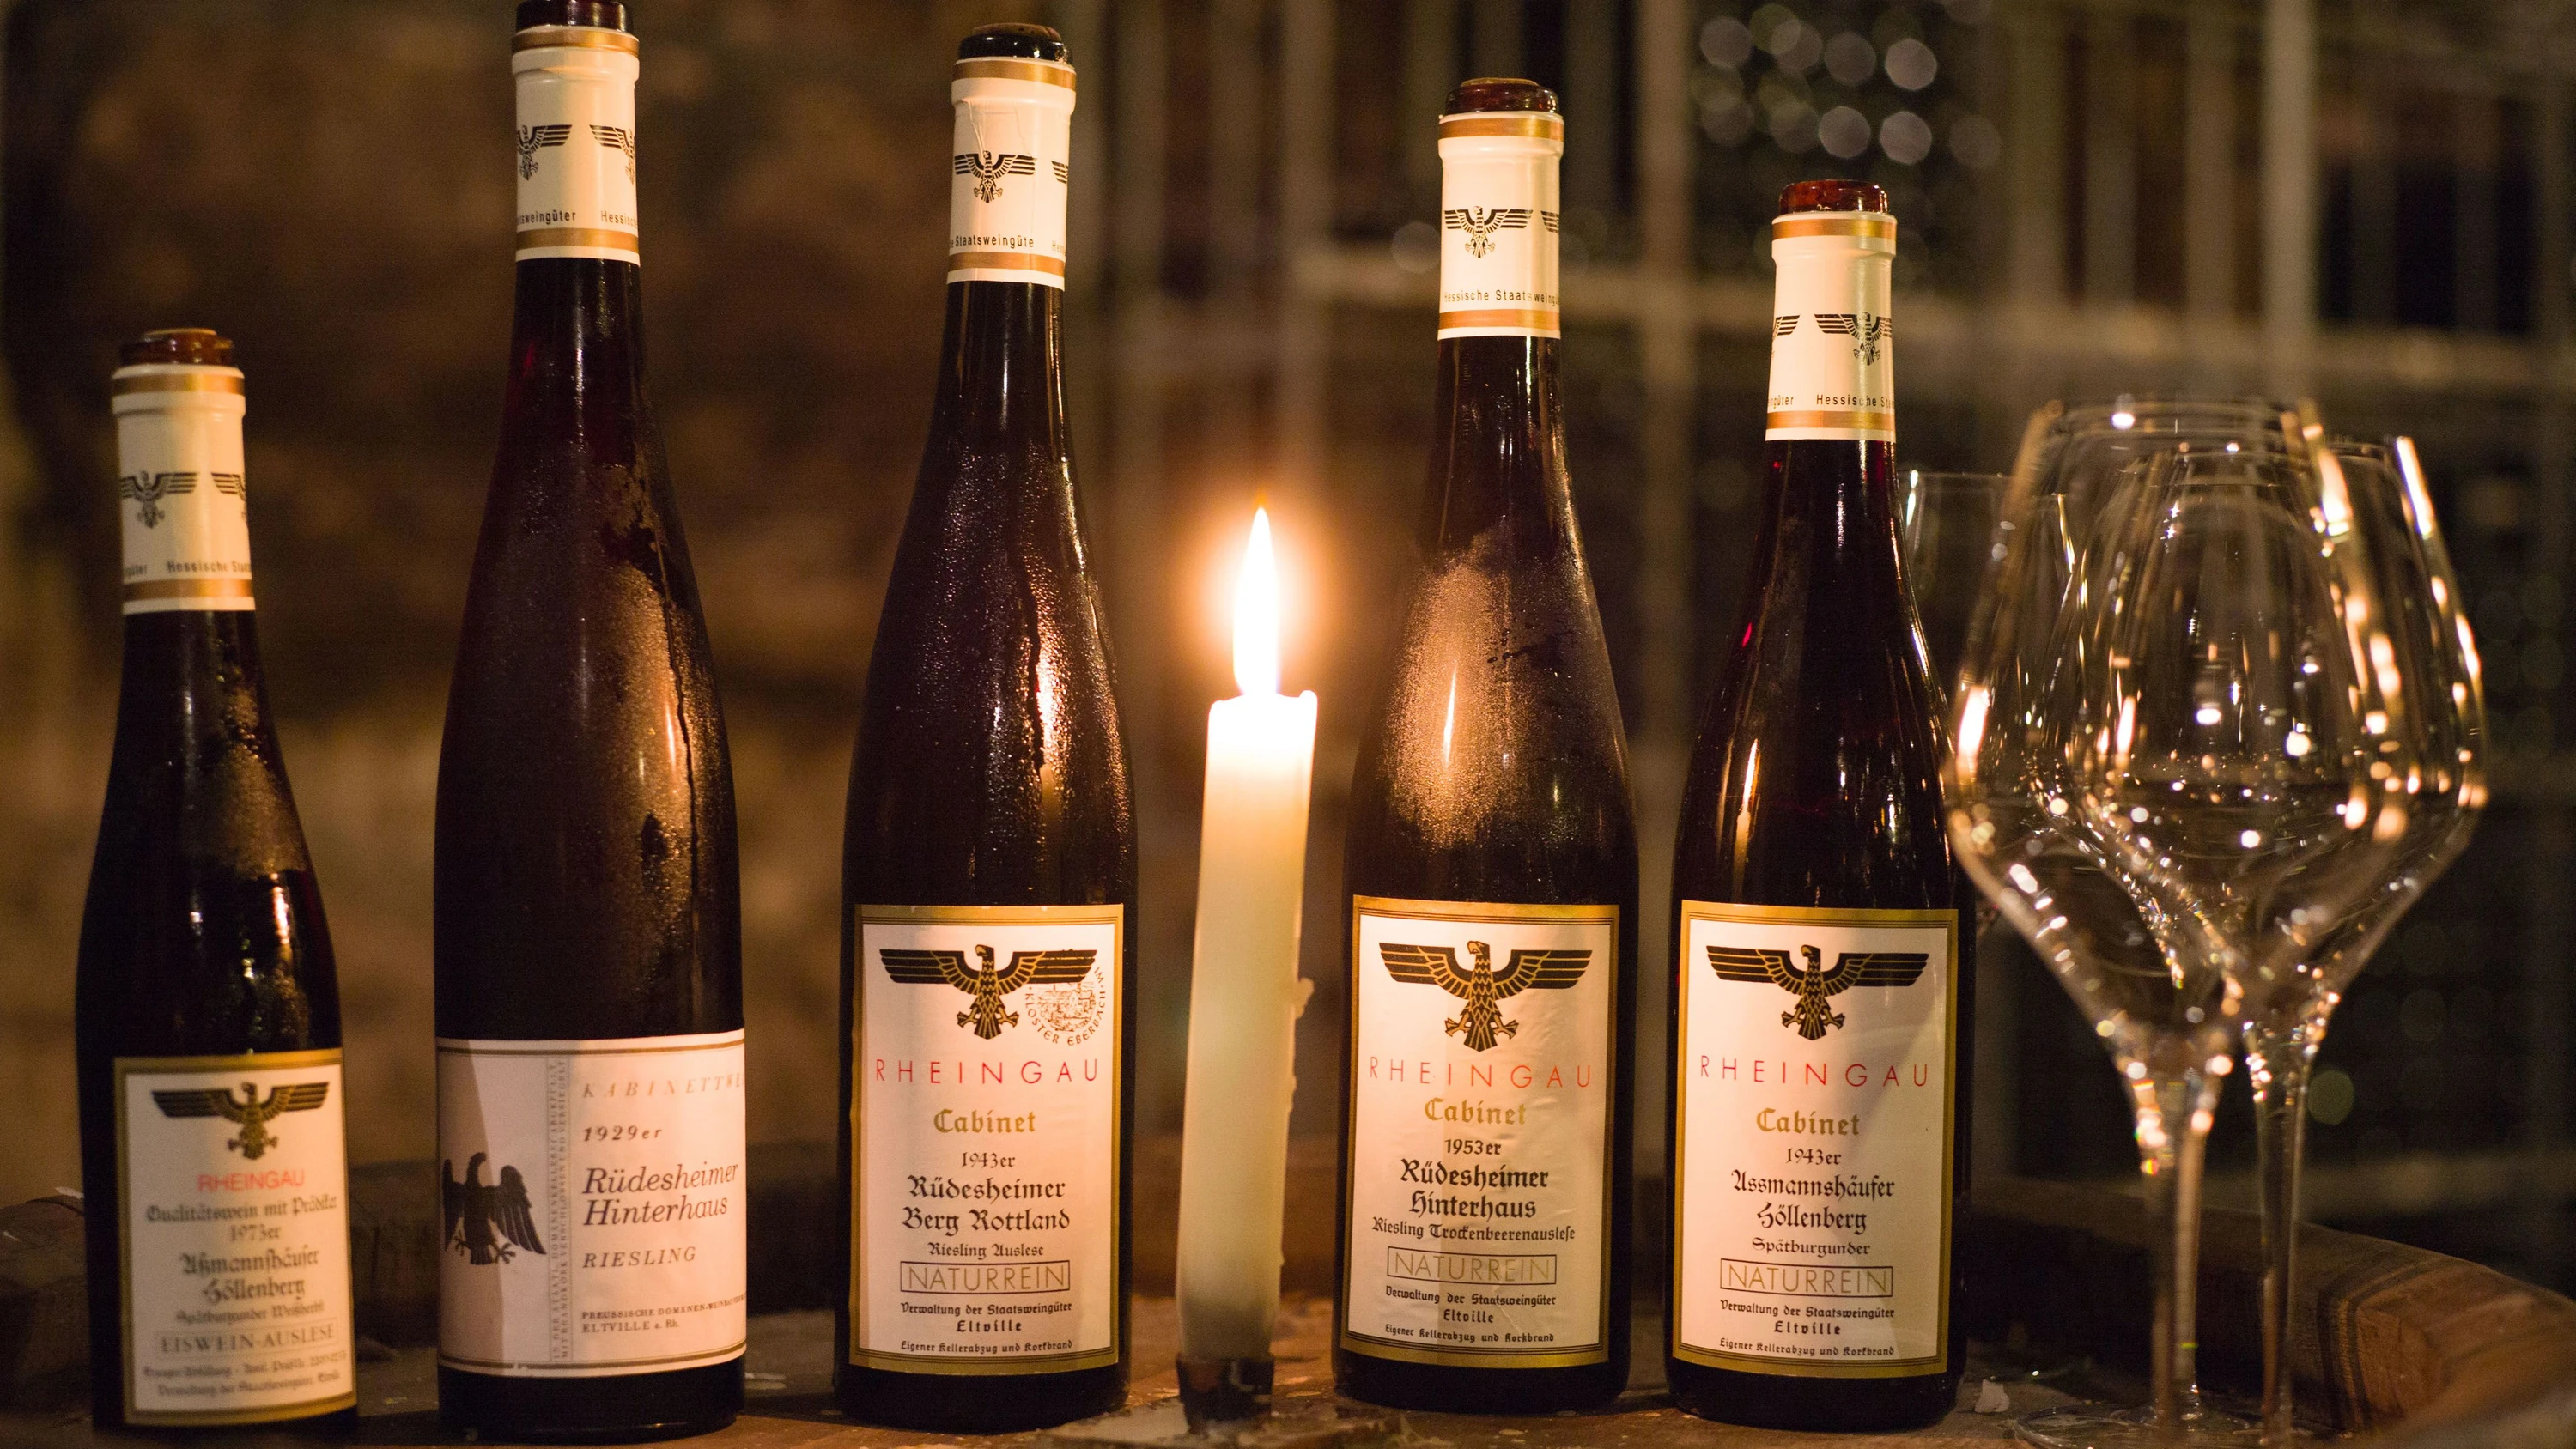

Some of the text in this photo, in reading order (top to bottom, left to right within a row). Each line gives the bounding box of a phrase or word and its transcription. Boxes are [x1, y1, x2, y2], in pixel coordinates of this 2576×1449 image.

[1816, 394, 1877, 407] Hessische
[1024, 991, 1106, 1046] KLOSTER EBERBACH
[875, 1058, 1097, 1084] RHEINGAU
[1370, 1056, 1591, 1088] RHEINGAU
[1701, 1055, 1928, 1088] RHEINGAU
[933, 1108, 1036, 1134] Cabinet
[1424, 1097, 1527, 1125] Cabinet
[1756, 1107, 1861, 1137] Cabinet
[584, 1125, 662, 1142] 1929er
[1444, 1138, 1502, 1155] 1953er
[1785, 1148, 1842, 1165] 1943er
[961, 1152, 1016, 1169] 1943er
[198, 1168, 304, 1191] RHEINGAU
[582, 1161, 738, 1195] Rüdesheimer
[1400, 1158, 1550, 1192] Rüdesheimer
[907, 1174, 1066, 1205] Rüdesheimer
[583, 1194, 728, 1228] Hinterhaus
[1408, 1190, 1537, 1222] Hinterhaus
[901, 1205, 1071, 1237] Berg Rottland
[1372, 1216, 1424, 1240] Riesling
[1756, 1202, 1868, 1235] Höllenberg
[583, 1246, 696, 1269] RIESLING
[927, 1241, 1044, 1260] Riesling Auslese
[1752, 1237, 1871, 1258] Spätburgunder
[908, 1264, 1065, 1291] NATURREIN
[1394, 1252, 1550, 1282] NATURREIN
[1728, 1264, 1887, 1294] NATURREIN
[1385, 1285, 1557, 1307] Verwaltung der Staatsweingüter
[581, 1309, 654, 1319] PREUSSISCHE
[901, 1302, 1072, 1317] Verwaltung der Staatsweingüter
[1720, 1300, 1895, 1319] Verwaltung der Staatsweingüter
[581, 1320, 650, 1333] ELTVILLE
[956, 1320, 1022, 1332] Eltville
[1385, 1324, 1554, 1343] Eigener Kellerabzug und Korkbrand
[1774, 1320, 1841, 1335] Eltville
[161, 1323, 335, 1354] EISWEIN-AUSLESE
[901, 1340, 936, 1353] Eigener
[939, 1341, 998, 1355] Kellerabzug
[1002, 1342, 1021, 1353] und
[1720, 1337, 1753, 1350] Eigener
[1756, 1342, 1815, 1356] Kellerabzug
[1820, 1345, 1839, 1355] und
